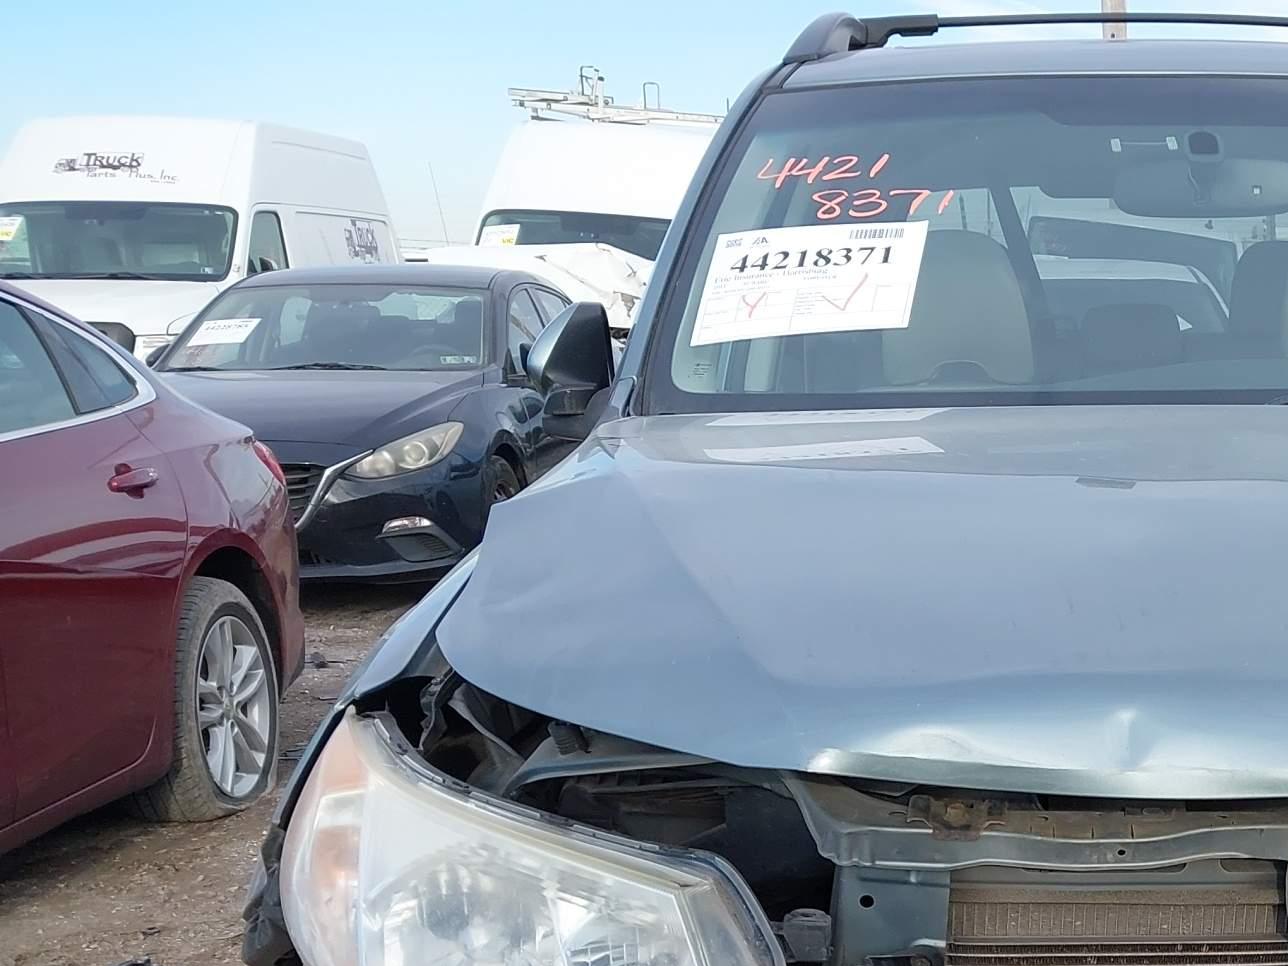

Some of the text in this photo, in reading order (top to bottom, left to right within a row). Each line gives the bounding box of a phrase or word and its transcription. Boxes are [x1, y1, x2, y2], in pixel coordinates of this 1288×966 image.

[757, 153, 889, 188] 4421
[812, 189, 954, 219] 8371
[730, 246, 896, 273] 44218371
